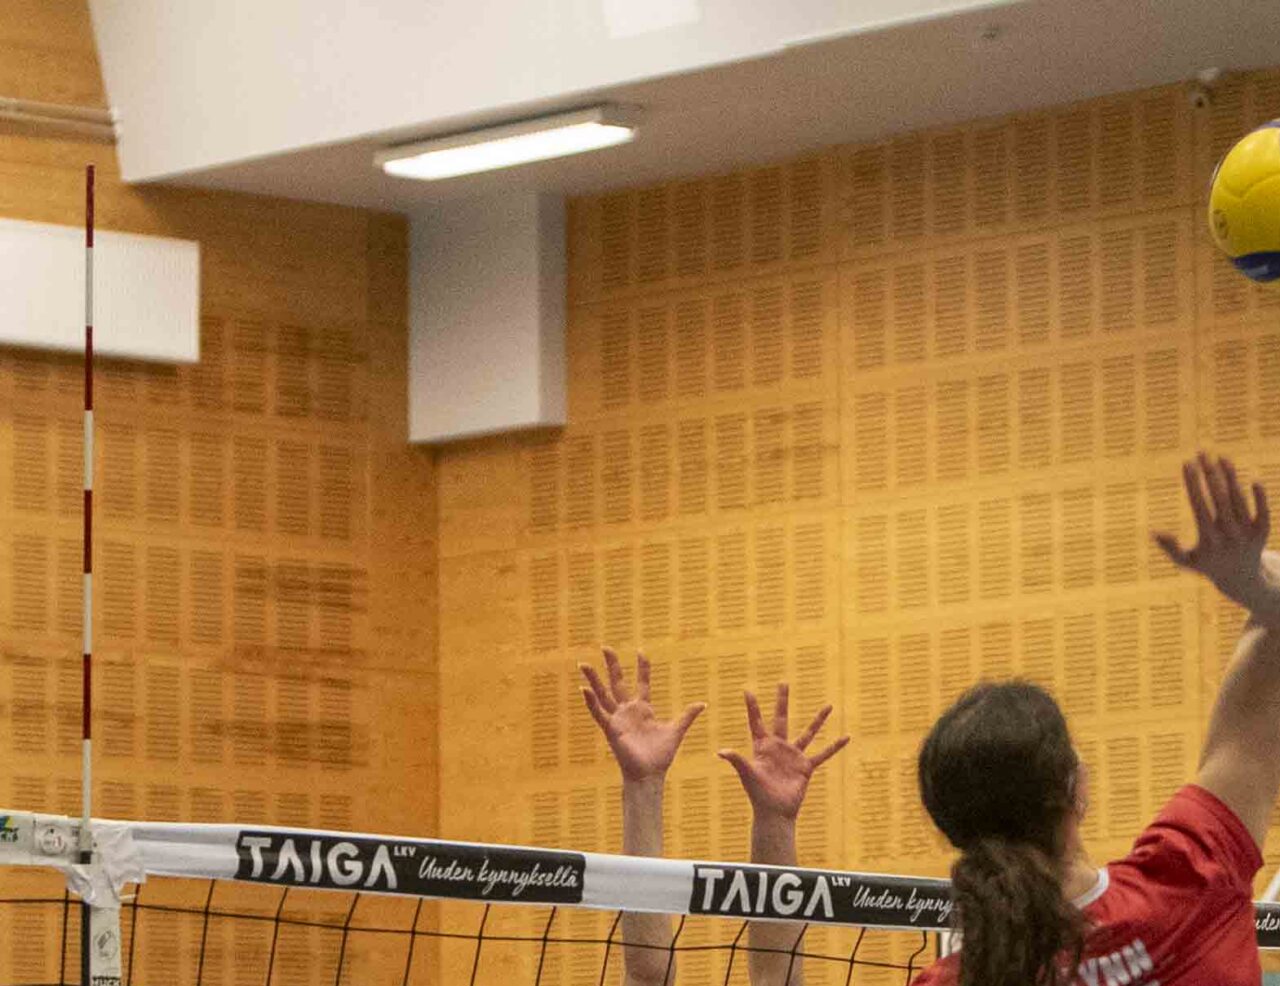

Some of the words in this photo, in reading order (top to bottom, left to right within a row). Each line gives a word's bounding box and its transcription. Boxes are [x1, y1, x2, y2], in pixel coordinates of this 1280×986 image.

[240, 835, 398, 889] TAIGA
[418, 855, 475, 883] Uuden
[477, 857, 579, 896] kynnyksellä
[697, 868, 835, 918] TAIGA
[852, 884, 904, 911] Uuden
